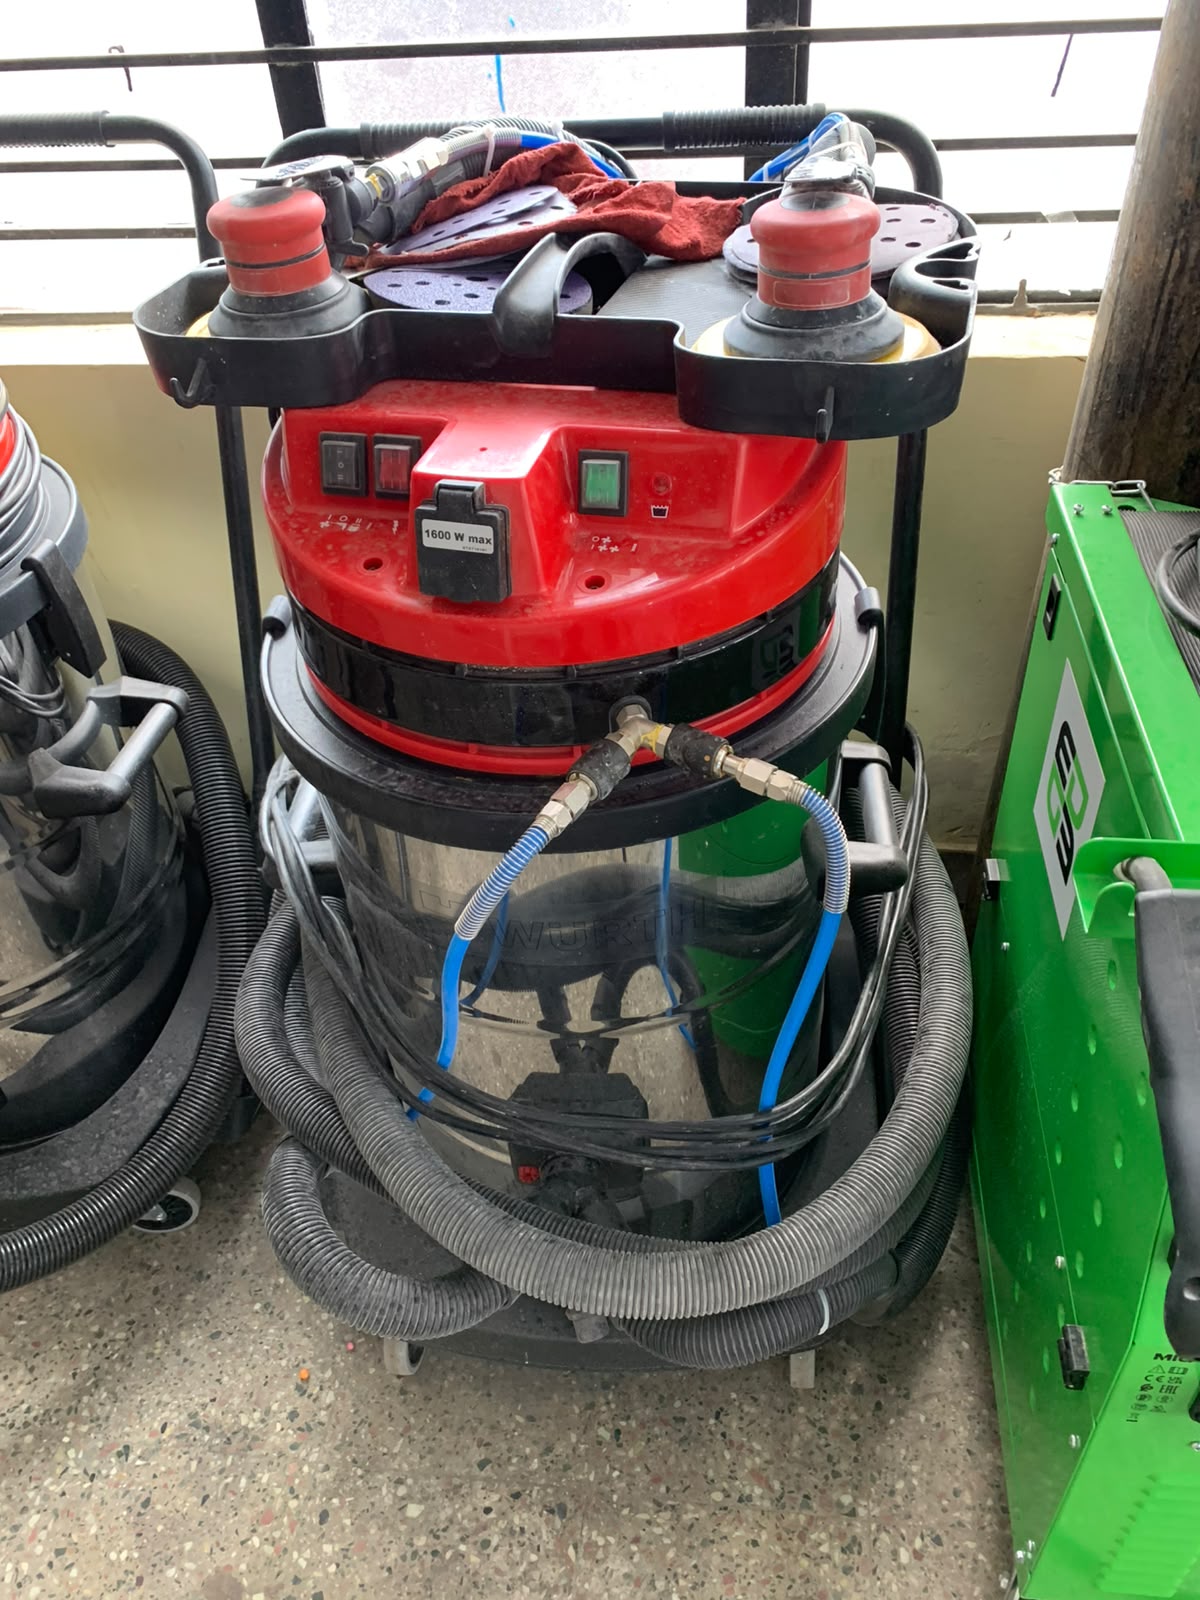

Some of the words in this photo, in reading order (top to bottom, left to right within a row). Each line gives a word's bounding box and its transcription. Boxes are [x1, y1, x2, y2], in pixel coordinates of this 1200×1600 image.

[424, 529, 451, 540] 1600
[454, 532, 465, 541] W
[468, 535, 492, 545] max
